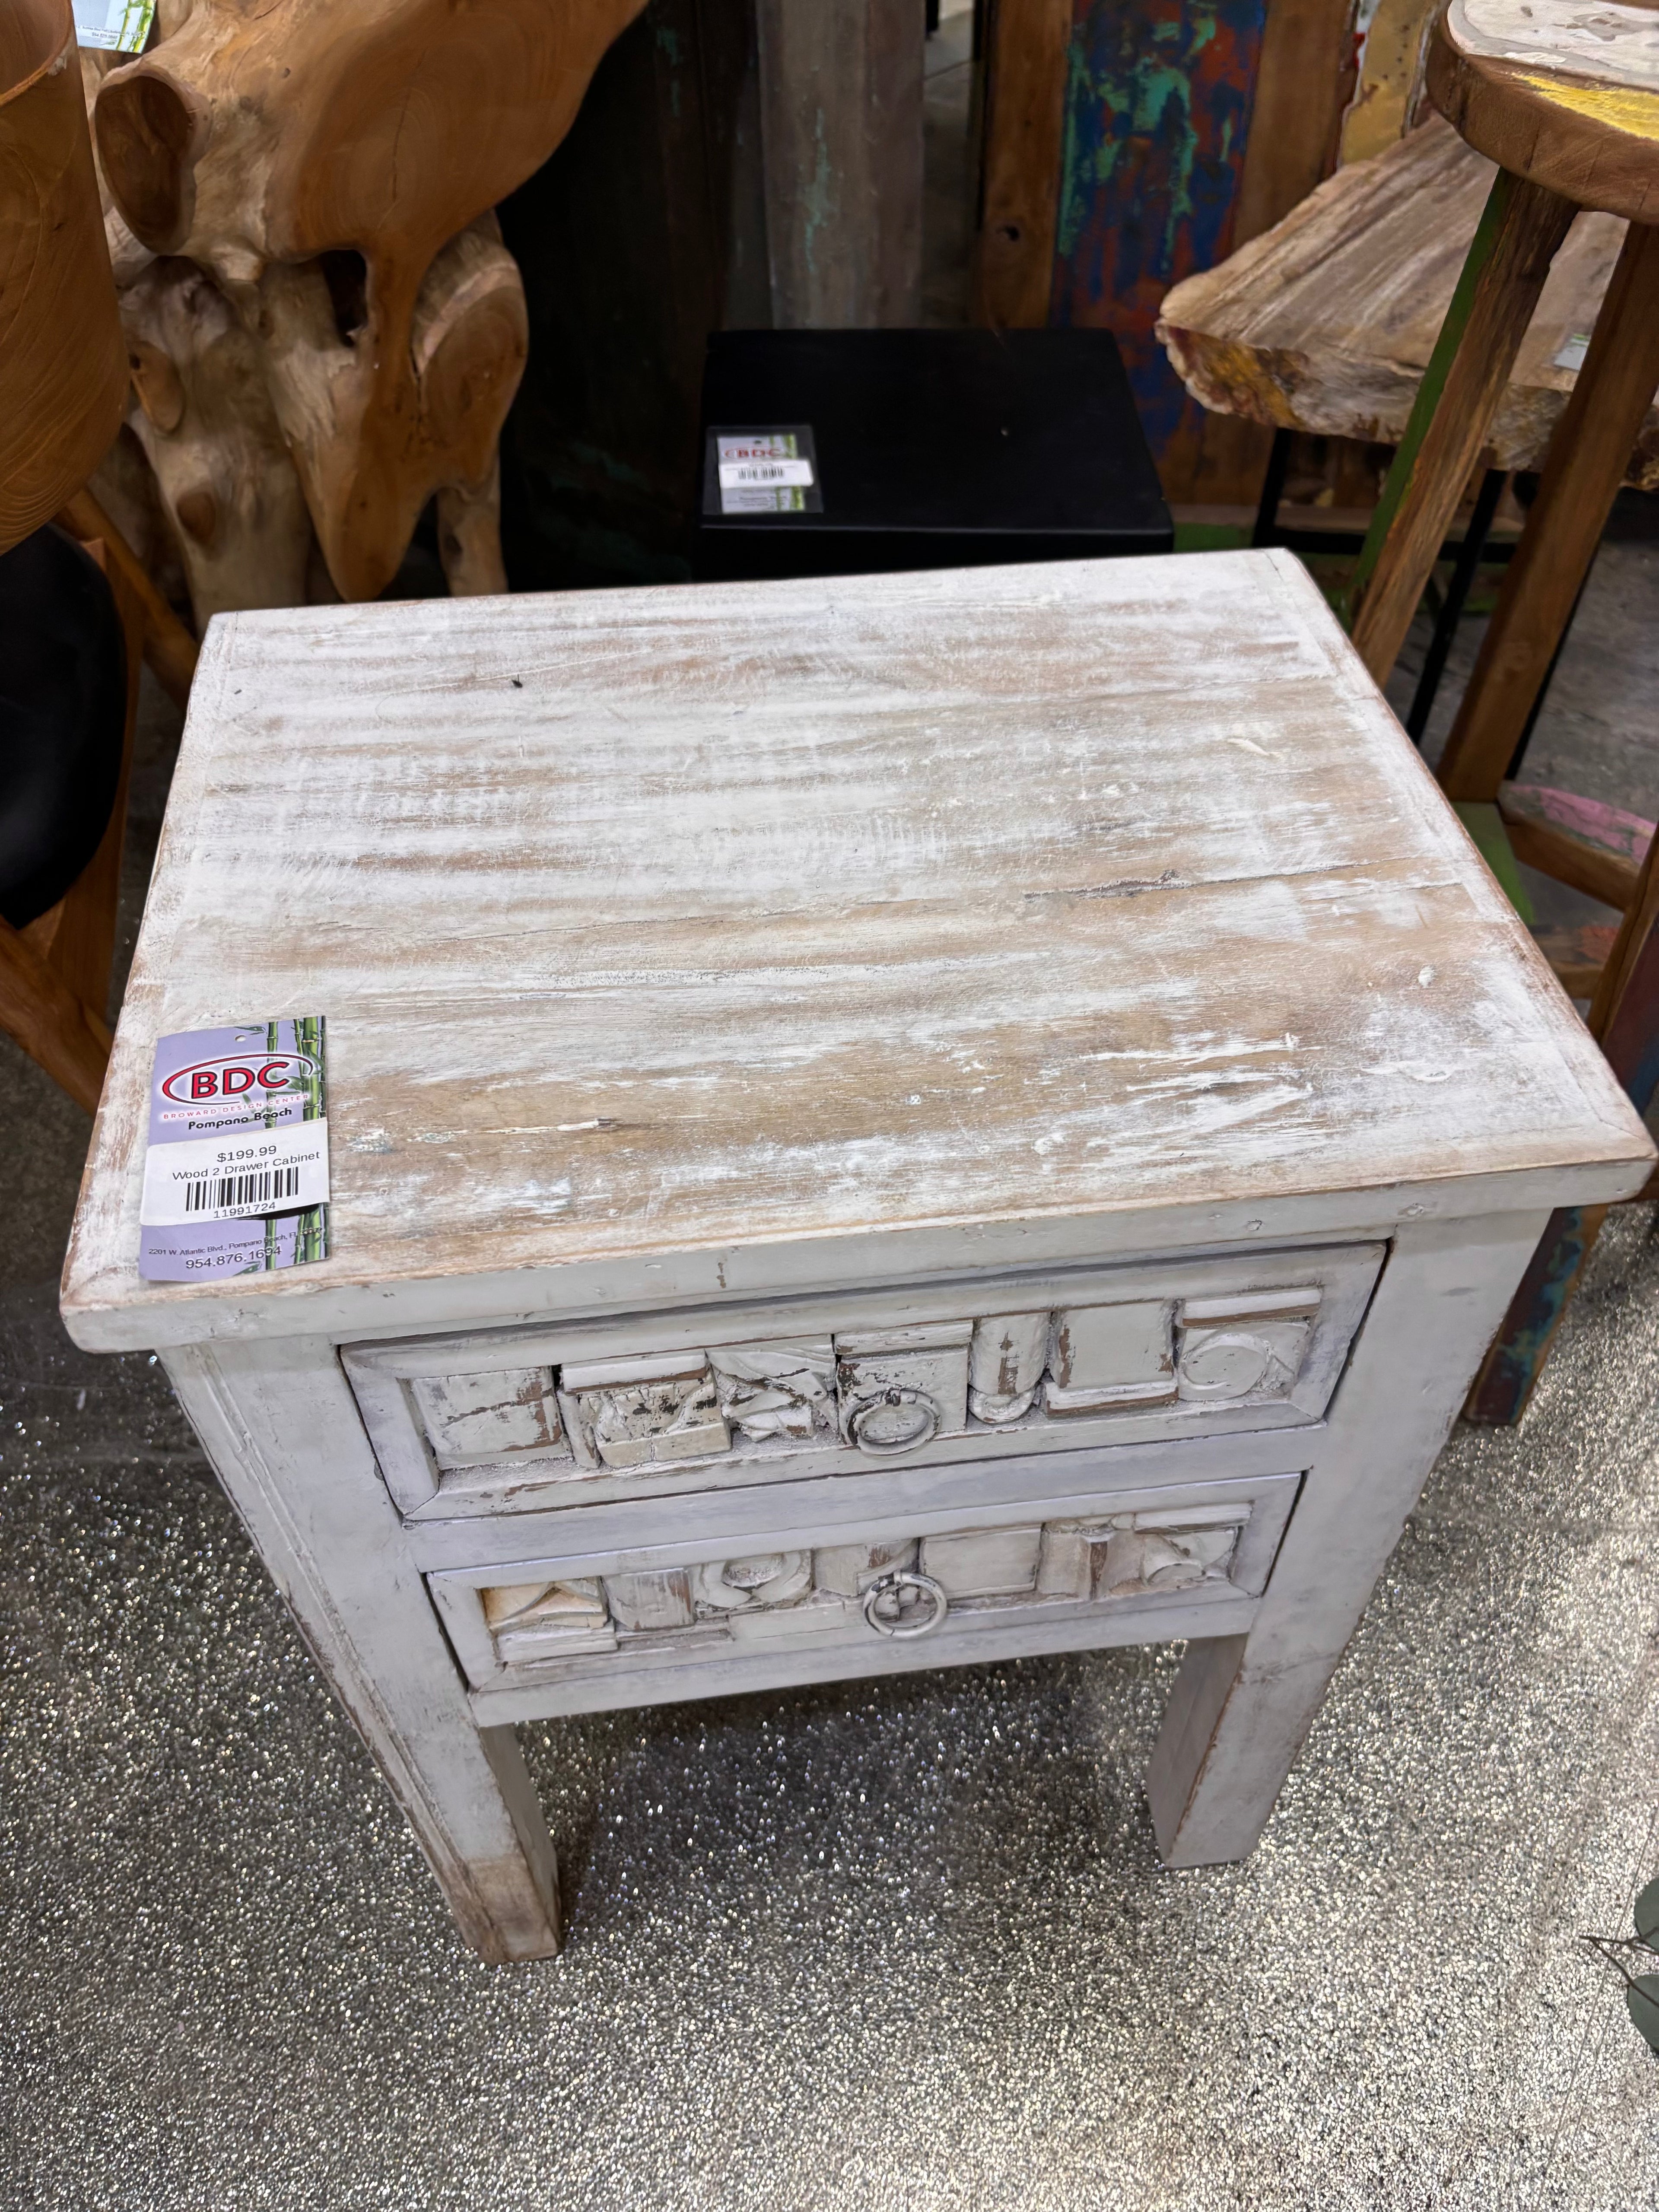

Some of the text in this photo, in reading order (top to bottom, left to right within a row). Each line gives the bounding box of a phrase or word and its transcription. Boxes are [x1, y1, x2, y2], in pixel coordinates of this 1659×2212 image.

[737, 448, 781, 458] BDC
[191, 1061, 290, 1099] BDC
[163, 1094, 309, 1119] BROWARD DESIGN CENTER
[188, 1108, 292, 1130] Pompano Beach
[217, 1145, 277, 1163] $199.99
[172, 1151, 321, 1180] Wood 2 Drawer Cabinet
[213, 1202, 276, 1219] 11991724
[180, 1247, 206, 1255] Atlantic
[229, 1239, 262, 1249] Pompano
[185, 1245, 281, 1269] 954.876.1694
